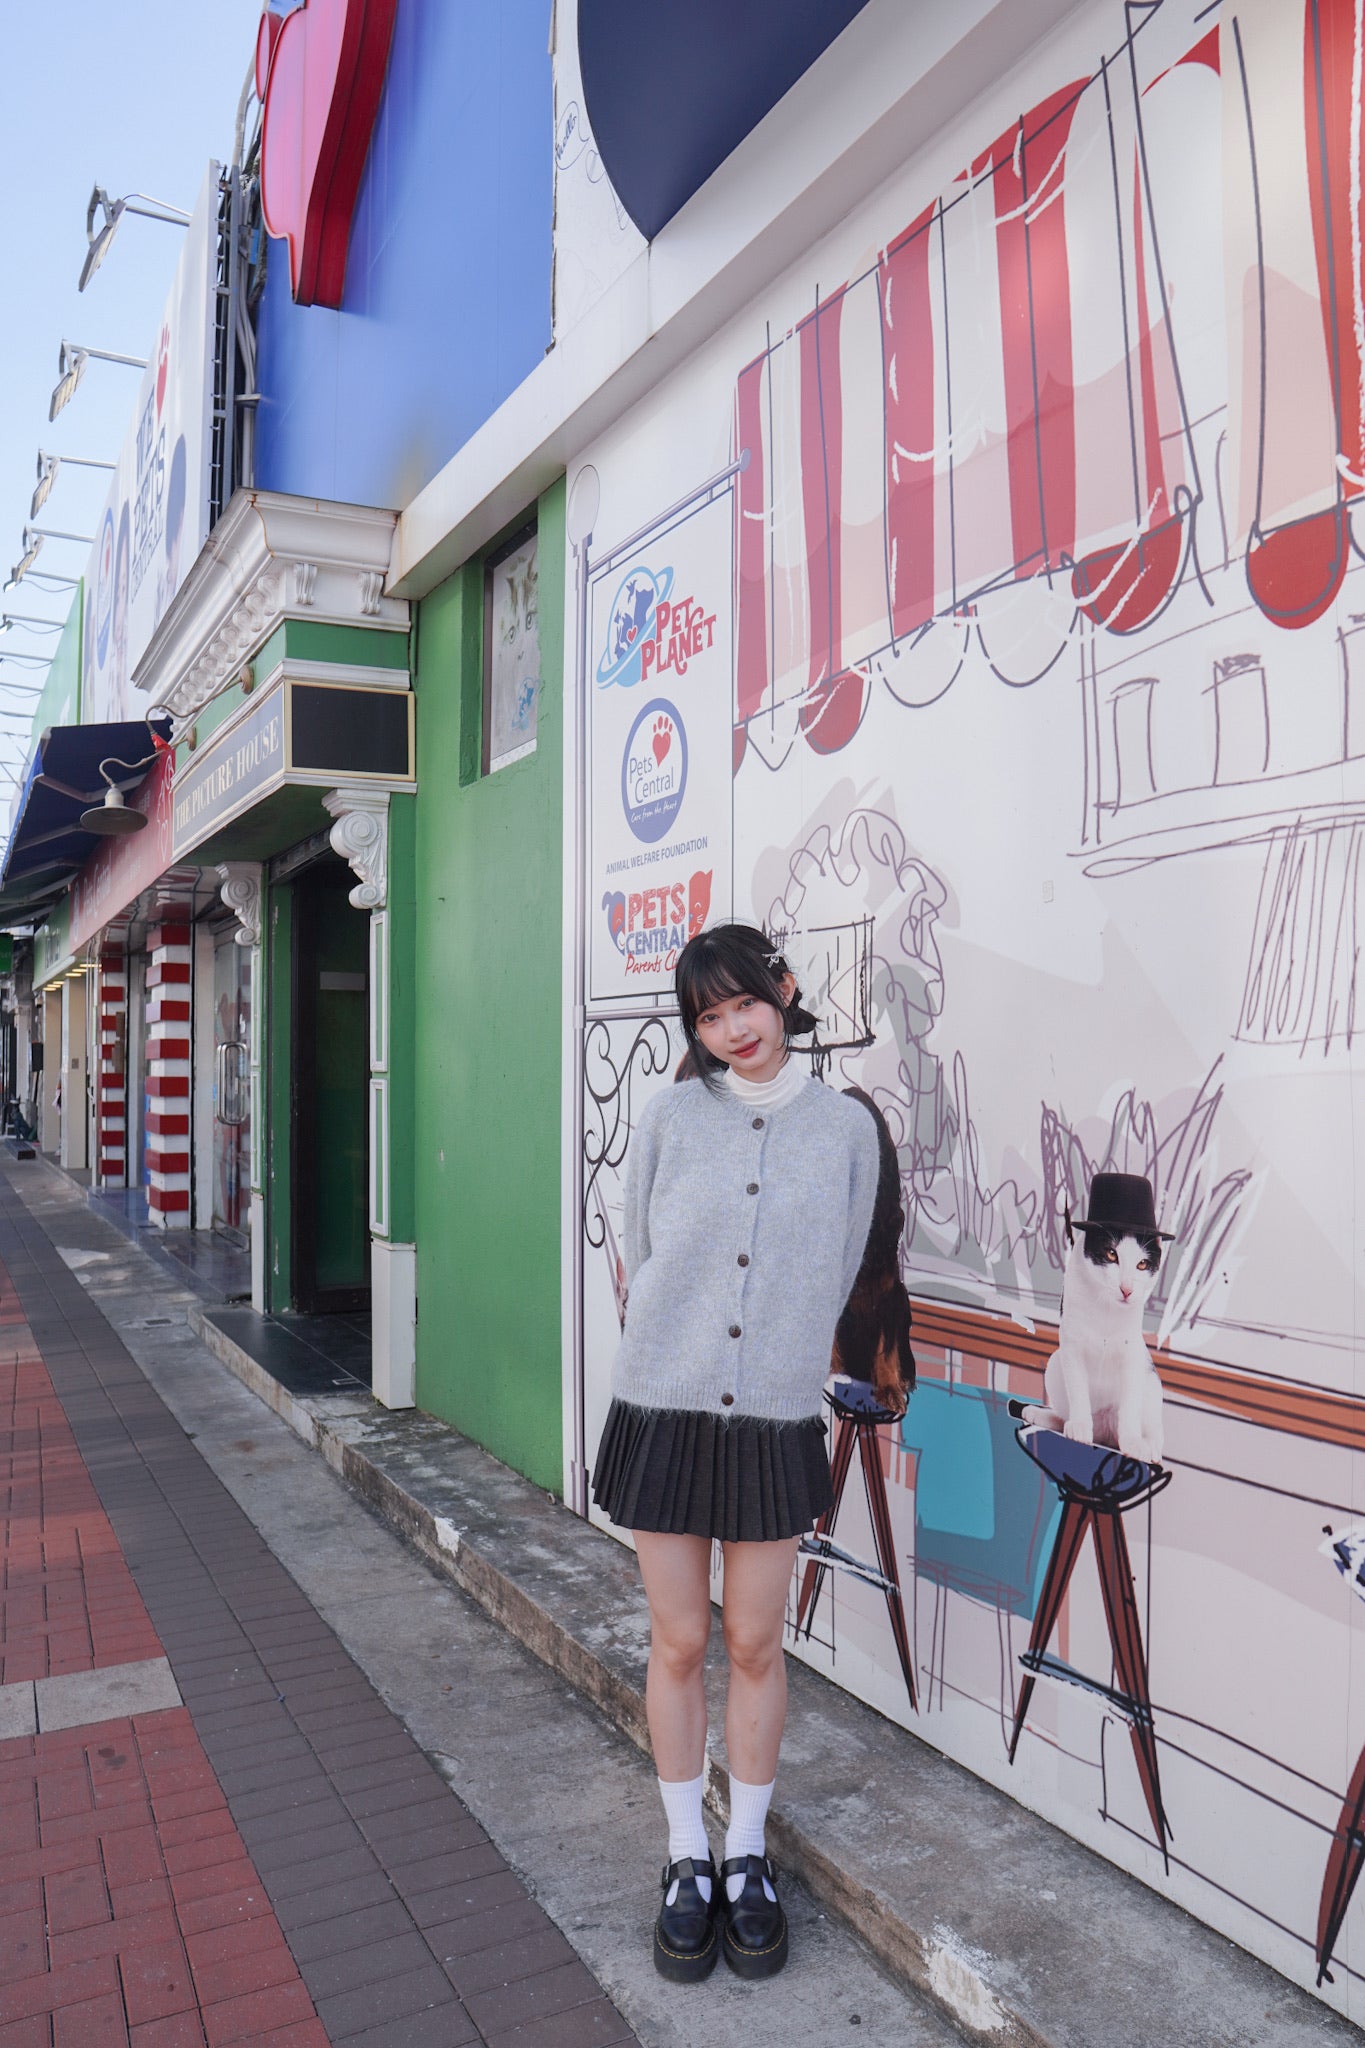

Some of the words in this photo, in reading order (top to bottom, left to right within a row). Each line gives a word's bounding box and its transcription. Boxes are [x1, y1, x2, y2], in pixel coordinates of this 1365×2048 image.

[132, 422, 166, 568] PETS
[655, 596, 694, 642] PET
[641, 606, 717, 682] PLANET
[175, 796, 192, 833] THE
[191, 757, 234, 820] PICTURE
[235, 716, 279, 783] HOUSE
[629, 756, 653, 784] Pets
[635, 766, 674, 804] Central
[606, 858, 630, 875] ANIMAL
[630, 849, 660, 871] WELFARE
[661, 836, 708, 862] FOUNDATION
[628, 883, 686, 932] PETS
[625, 924, 687, 956] CENTRAL
[624, 951, 661, 977] Parents
